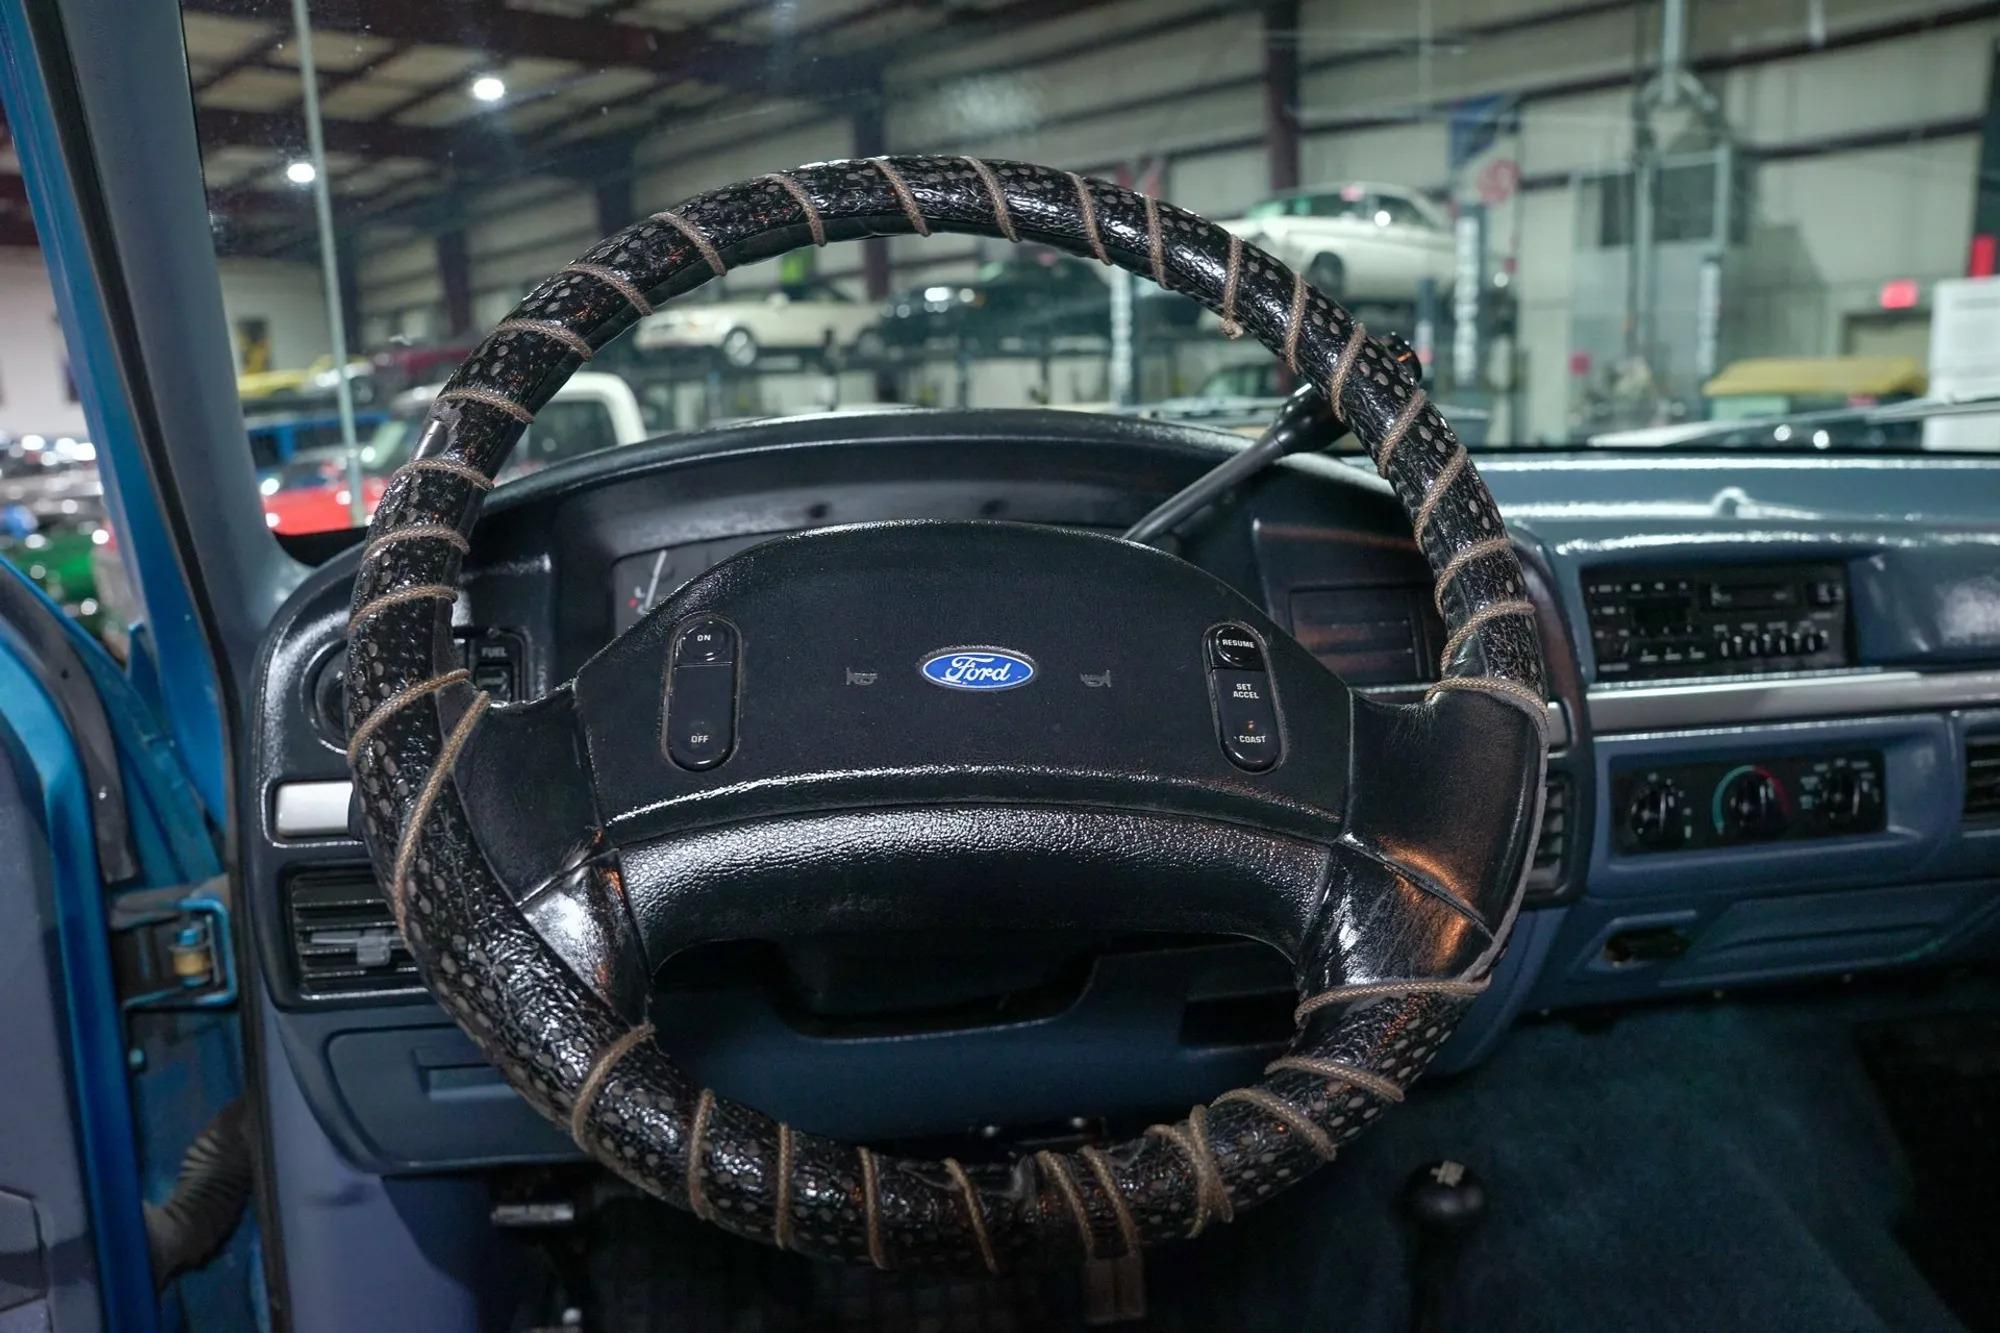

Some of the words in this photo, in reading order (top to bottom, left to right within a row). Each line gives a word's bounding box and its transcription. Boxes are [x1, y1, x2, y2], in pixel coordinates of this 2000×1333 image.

[1222, 639, 1255, 649] RESUME
[481, 646, 508, 658] FUEL
[940, 656, 1012, 683] Ford
[1236, 683, 1251, 691] SET
[1233, 690, 1259, 699] ACCEL
[691, 735, 709, 743] OFF
[1239, 735, 1266, 743] COAST
